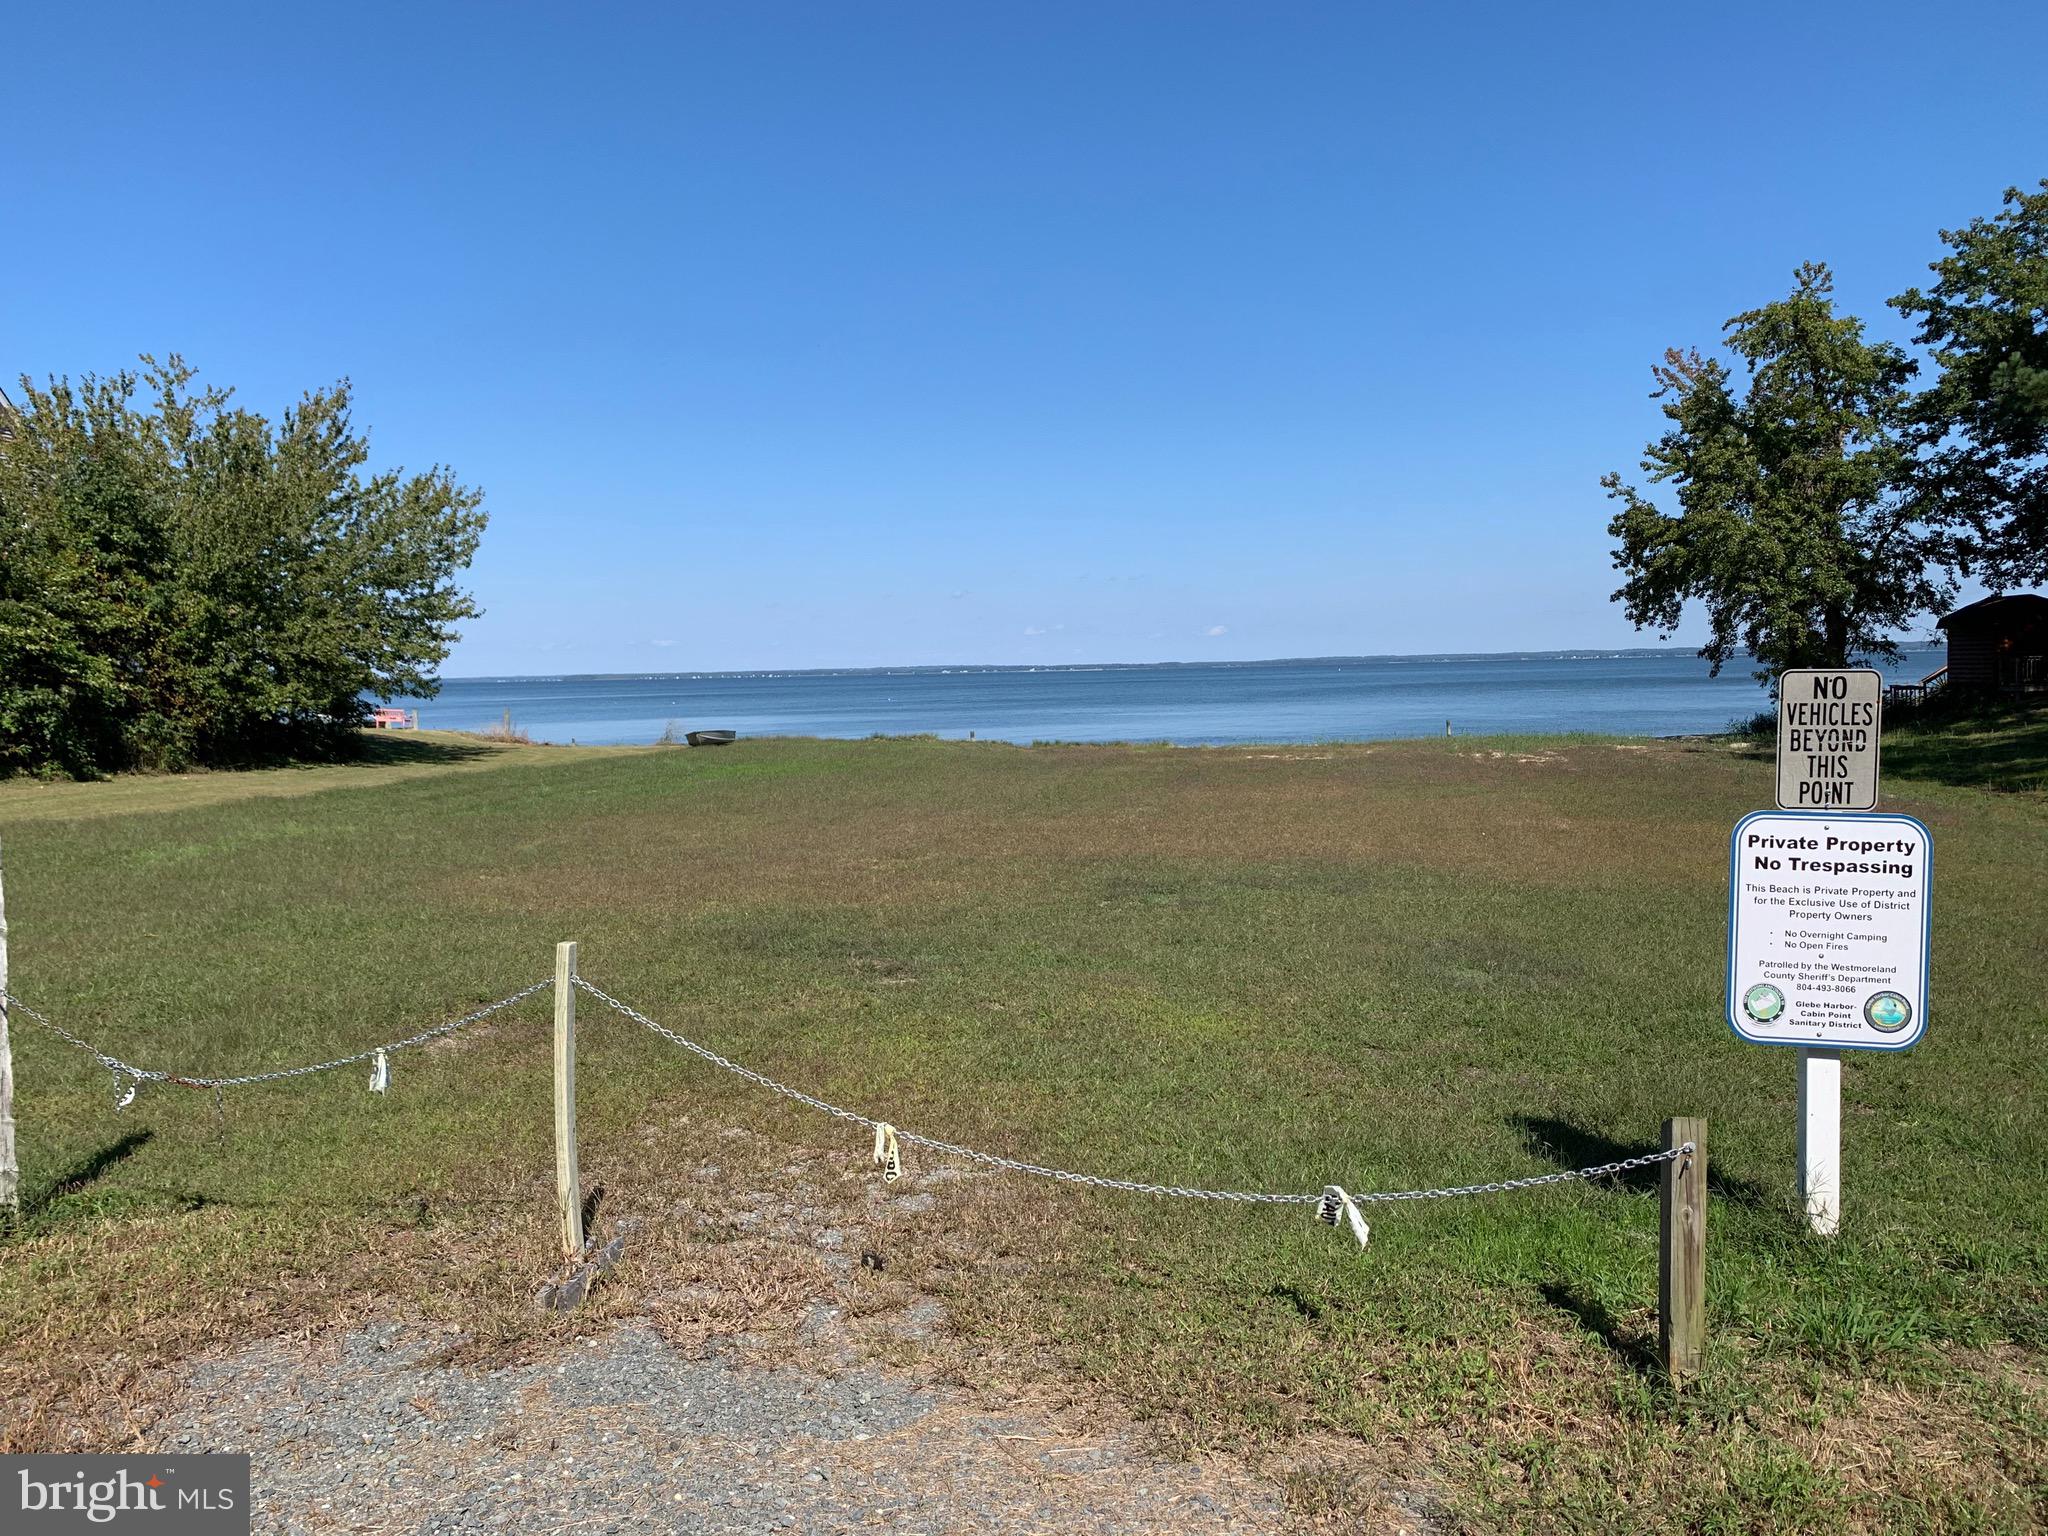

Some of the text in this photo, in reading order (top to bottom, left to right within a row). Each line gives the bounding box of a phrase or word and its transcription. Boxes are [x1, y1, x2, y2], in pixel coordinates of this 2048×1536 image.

[1814, 676, 1847, 699] NO
[1787, 703, 1872, 726] VEHICLES
[1790, 729, 1866, 752] BEYOND
[1808, 755, 1847, 778] THIS
[1799, 781, 1854, 804] POINT
[1748, 835, 1916, 856] Private Property
[1755, 856, 1913, 878] No Trespassing
[1746, 884, 1916, 898] This Beach is Private Property and
[1754, 896, 1767, 905] for
[1770, 897, 1785, 905] the
[1788, 898, 1835, 907] Exclusive
[1839, 900, 1858, 908] Use
[1874, 901, 1910, 910] District
[1789, 910, 1872, 921] Property Owners
[1800, 931, 1844, 941] Overnight
[1847, 933, 1888, 943] Camping
[1785, 941, 1797, 949] No
[1800, 942, 1823, 951] Open
[1759, 960, 1897, 973] Patrolled by the Westmoreland
[1764, 971, 1891, 984] County Sheriff's Department
[1797, 984, 1856, 993] 804-493-8066
[1796, 1001, 1821, 1009] Glebe
[1789, 1019, 1862, 1029] Sanitary District
